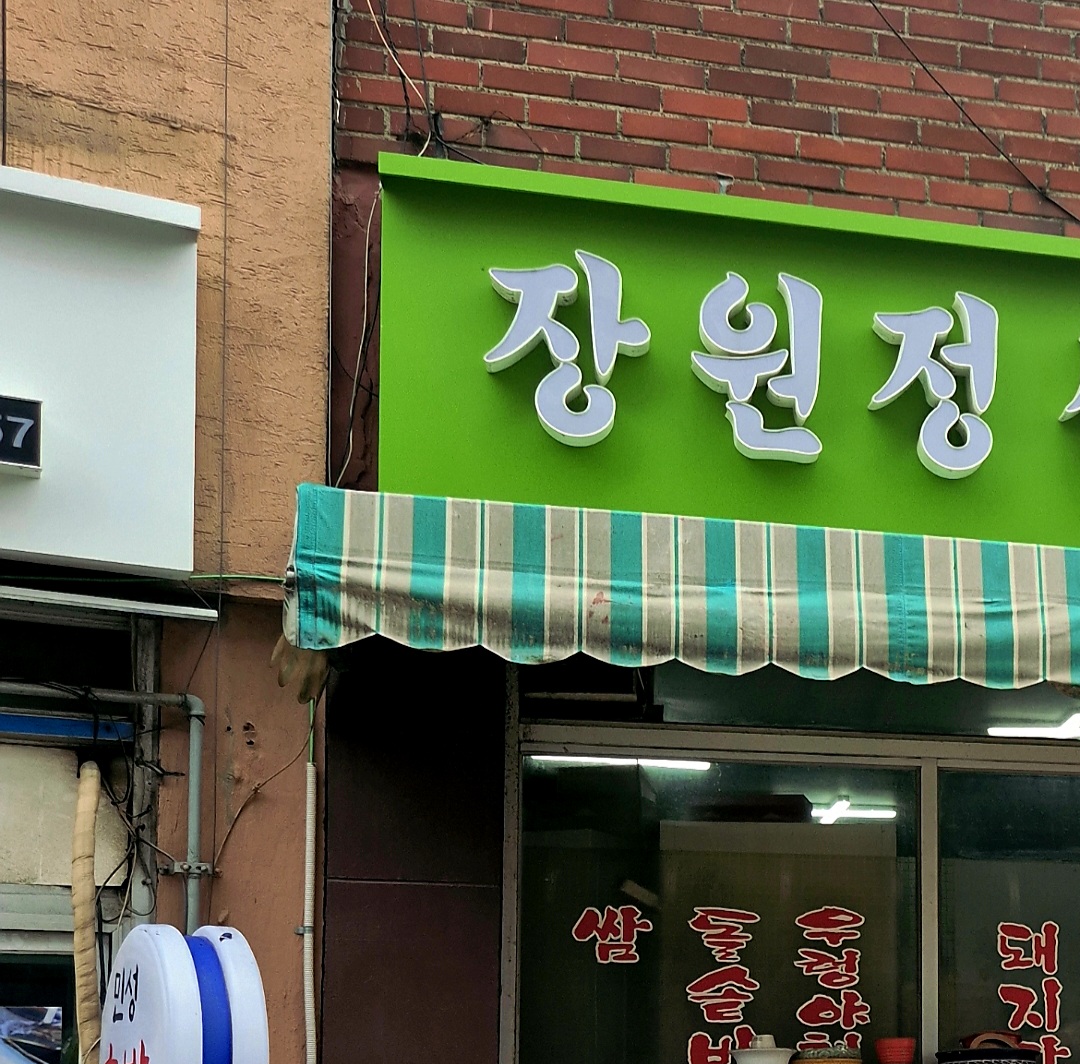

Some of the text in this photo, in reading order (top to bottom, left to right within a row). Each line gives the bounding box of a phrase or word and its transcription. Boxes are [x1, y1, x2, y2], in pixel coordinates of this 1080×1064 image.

[483, 249, 998, 480] 장원정
[0, 414, 34, 448] 7
[113, 964, 139, 1023] 민성
